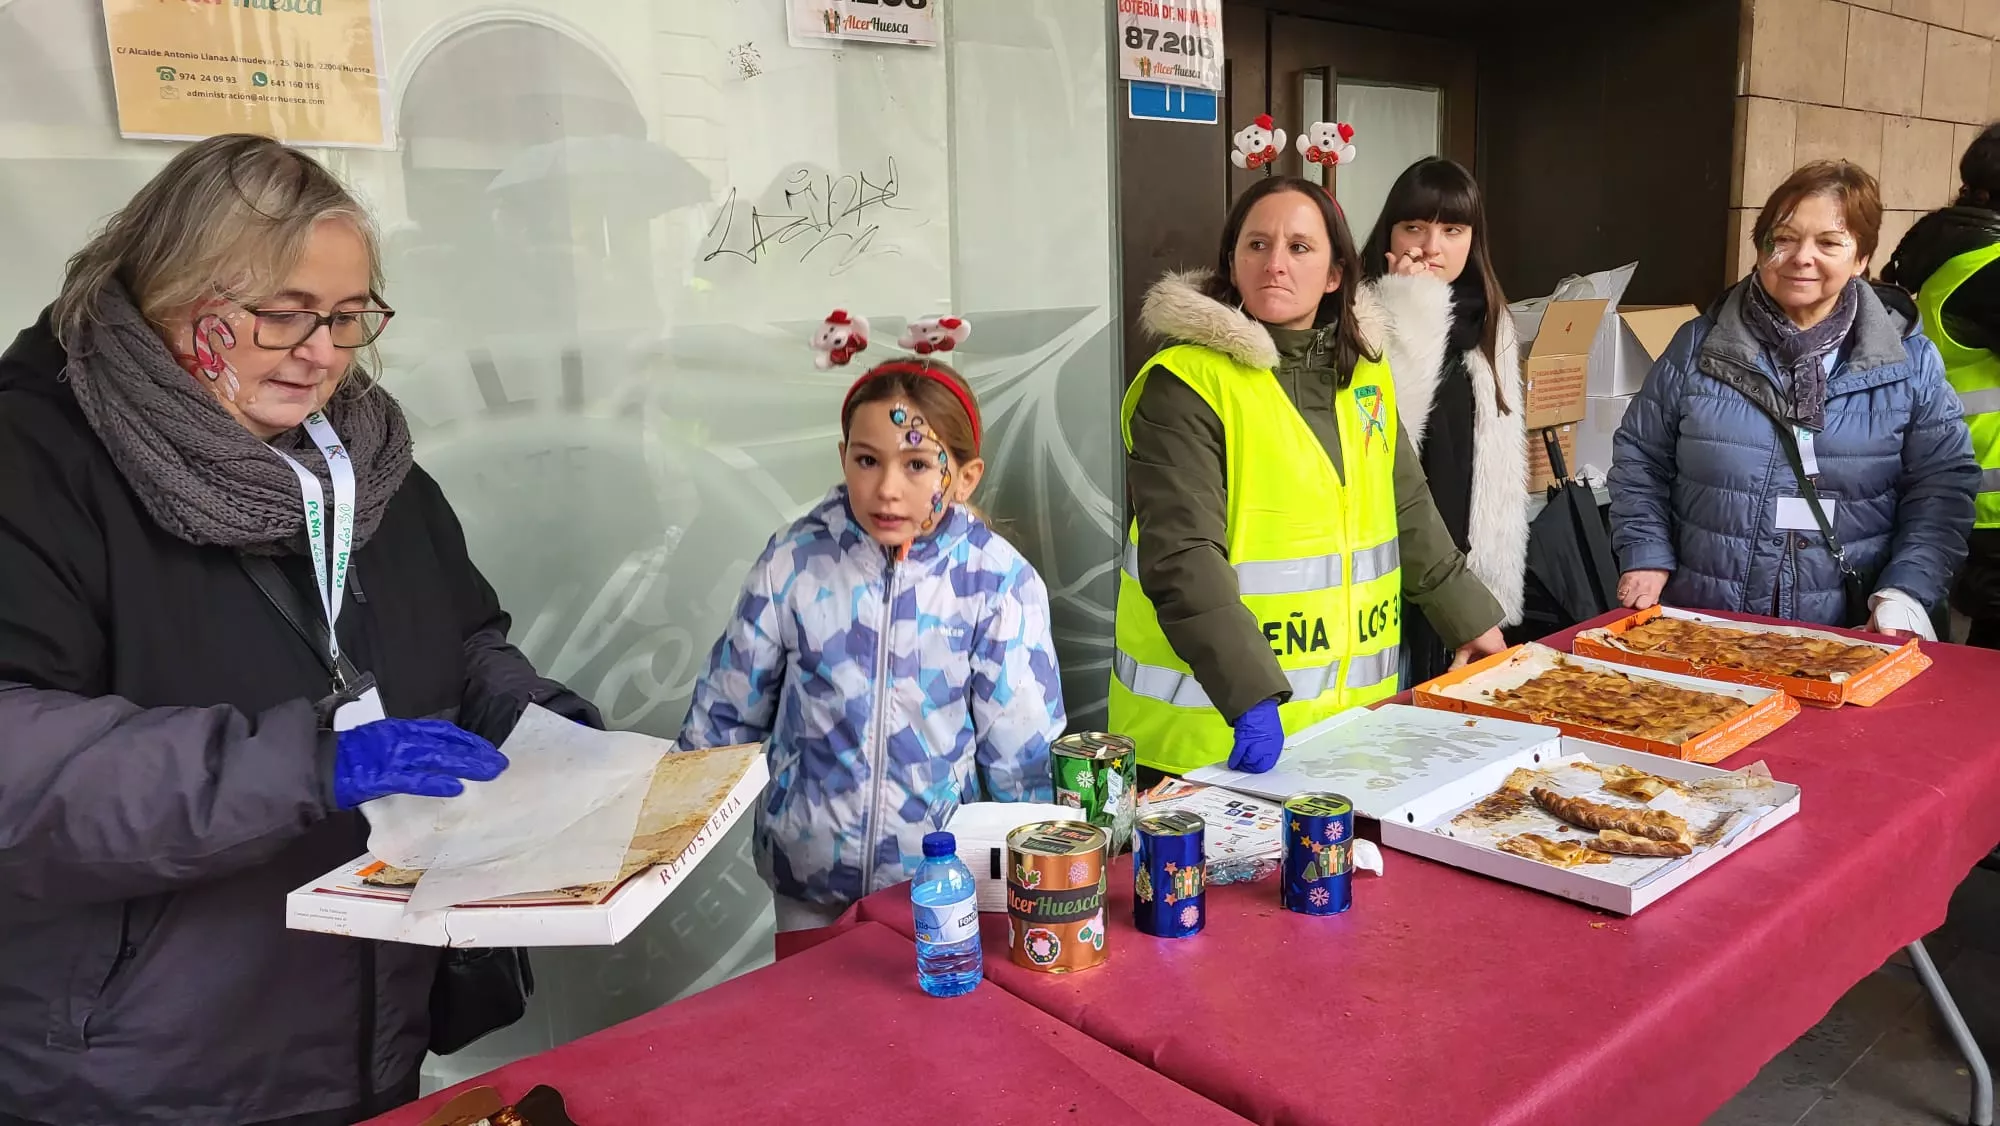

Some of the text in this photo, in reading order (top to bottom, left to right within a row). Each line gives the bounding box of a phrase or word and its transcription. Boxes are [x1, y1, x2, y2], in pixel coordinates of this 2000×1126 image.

[116, 46, 127, 55] C/
[128, 47, 162, 57] Alcalde
[163, 50, 199, 60] Antonio
[200, 53, 229, 62] Llanas
[342, 65, 371, 74] Huesca
[1125, 25, 1215, 60] 87.206
[178, 72, 237, 84] 974 24 09 93
[336, 551, 349, 589] PEÑA
[1263, 593, 1401, 656] EÑA LOS 3
[659, 796, 742, 886] REPOSTERIA
